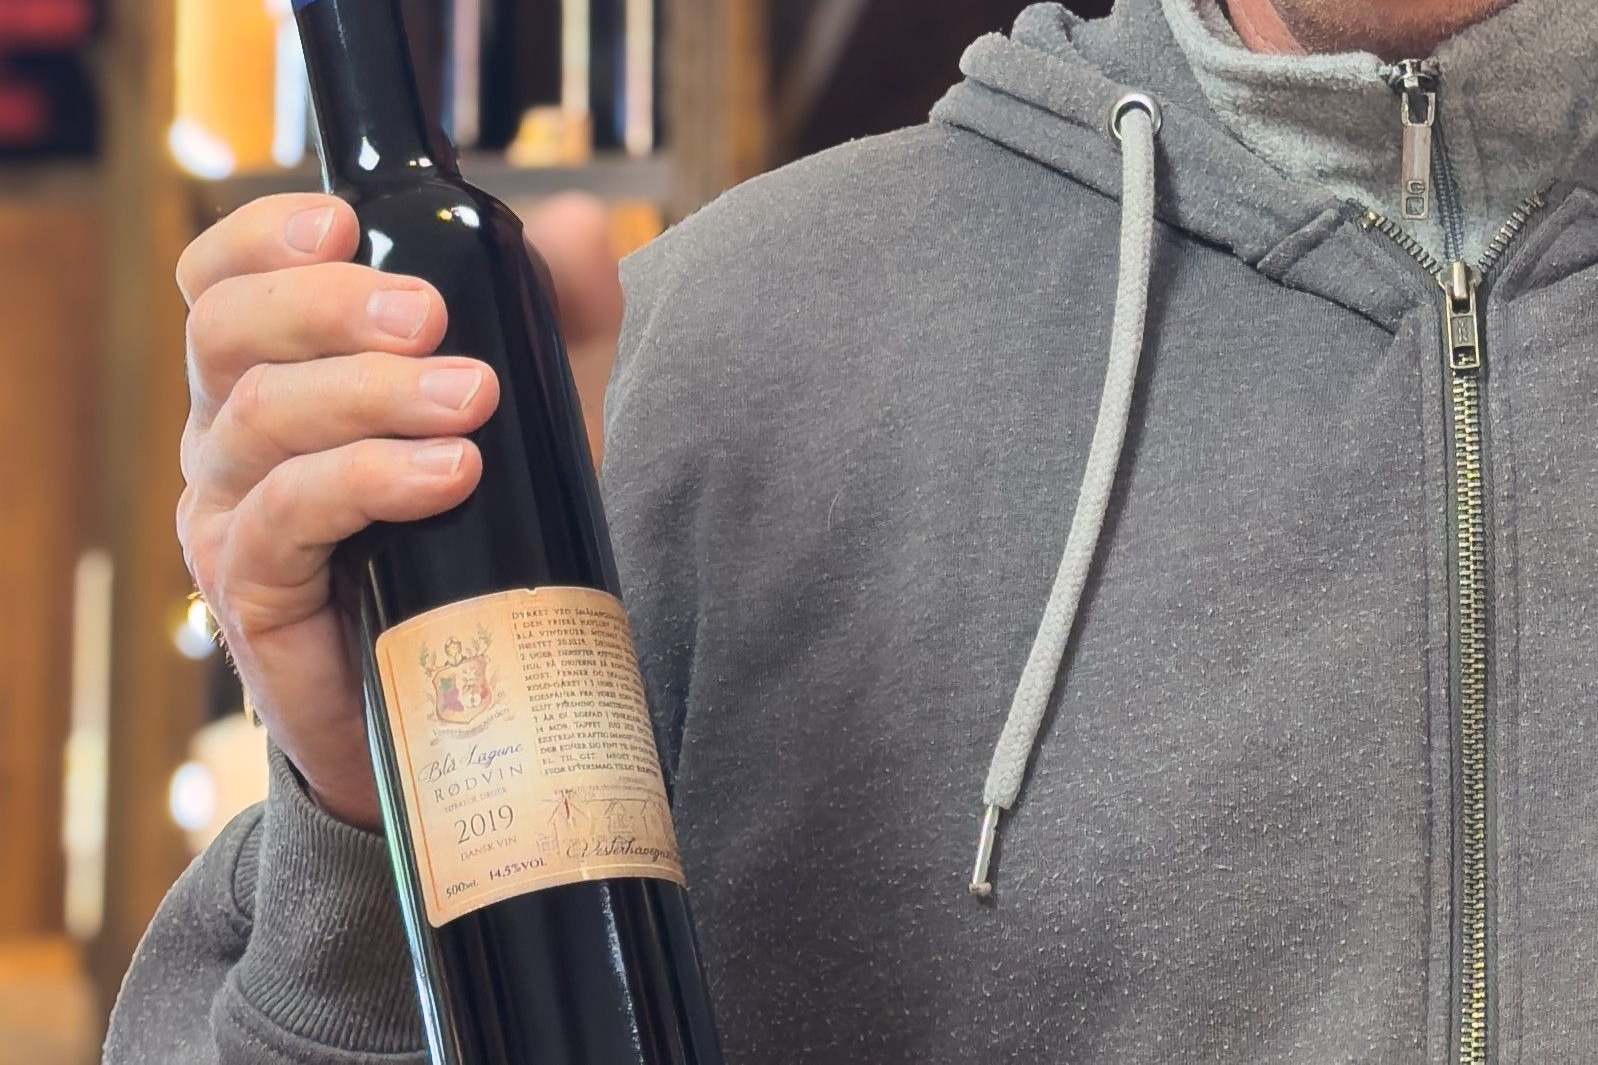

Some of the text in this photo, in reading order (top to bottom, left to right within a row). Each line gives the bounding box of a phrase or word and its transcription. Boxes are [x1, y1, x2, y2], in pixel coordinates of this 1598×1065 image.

[433, 763, 525, 803] RØDVIN
[454, 804, 513, 845] 2019
[461, 835, 517, 862] DANSK VIN
